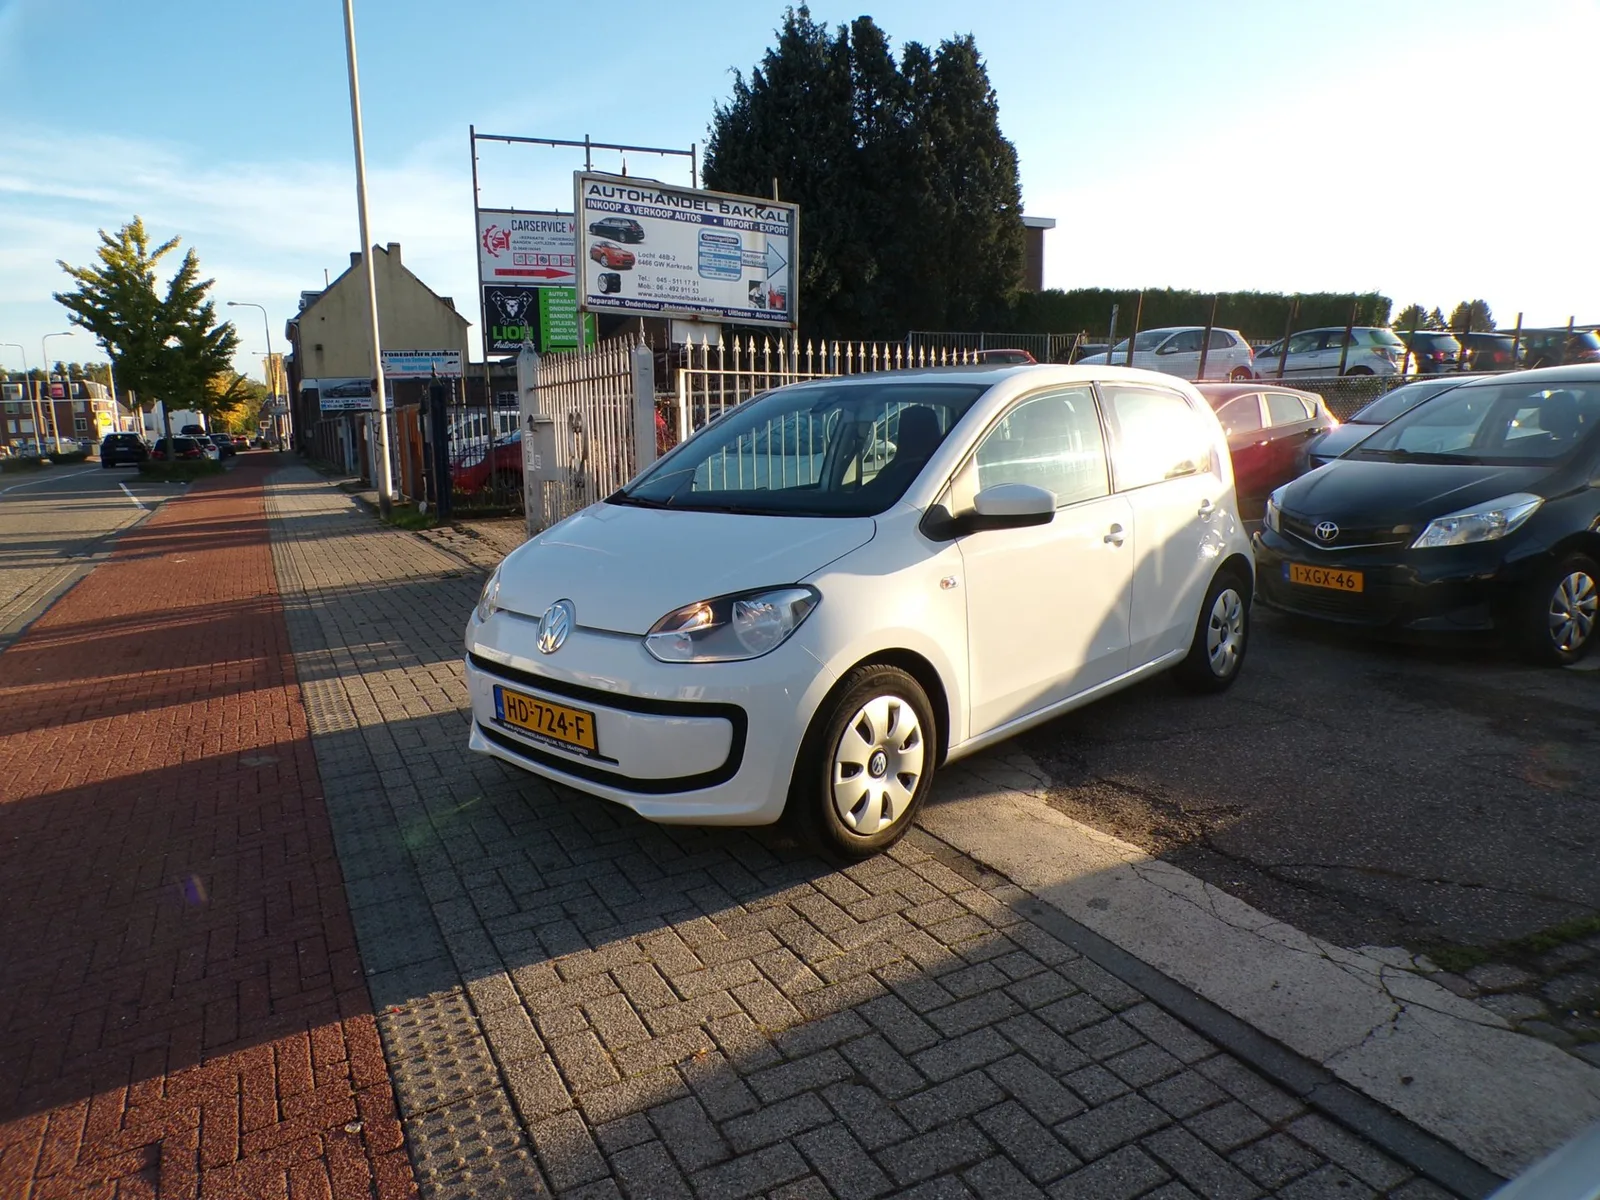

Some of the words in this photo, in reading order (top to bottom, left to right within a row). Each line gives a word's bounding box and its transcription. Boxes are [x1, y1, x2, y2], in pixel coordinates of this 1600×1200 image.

[587, 199, 622, 212] INKOOP
[623, 204, 631, 213] &
[632, 205, 673, 219] VERKOOP
[674, 212, 702, 223] AUTOS
[588, 184, 714, 212] AUTOHANDEL
[719, 203, 789, 224] BAKKALI
[511, 219, 567, 233] CARSERVICE
[568, 222, 575, 233] M
[723, 218, 754, 230] IMPORT
[759, 223, 789, 235] EXPORT
[653, 260, 665, 268] GW
[666, 262, 693, 271] Kerkrade
[656, 276, 668, 284] 045
[587, 296, 621, 306] Reparatie
[624, 300, 660, 310] Onderhoud
[728, 309, 752, 318] Uitlezen
[492, 325, 534, 340] LION
[1294, 566, 1355, 589] 1-XGX-46
[506, 695, 585, 741] HD-724-F
